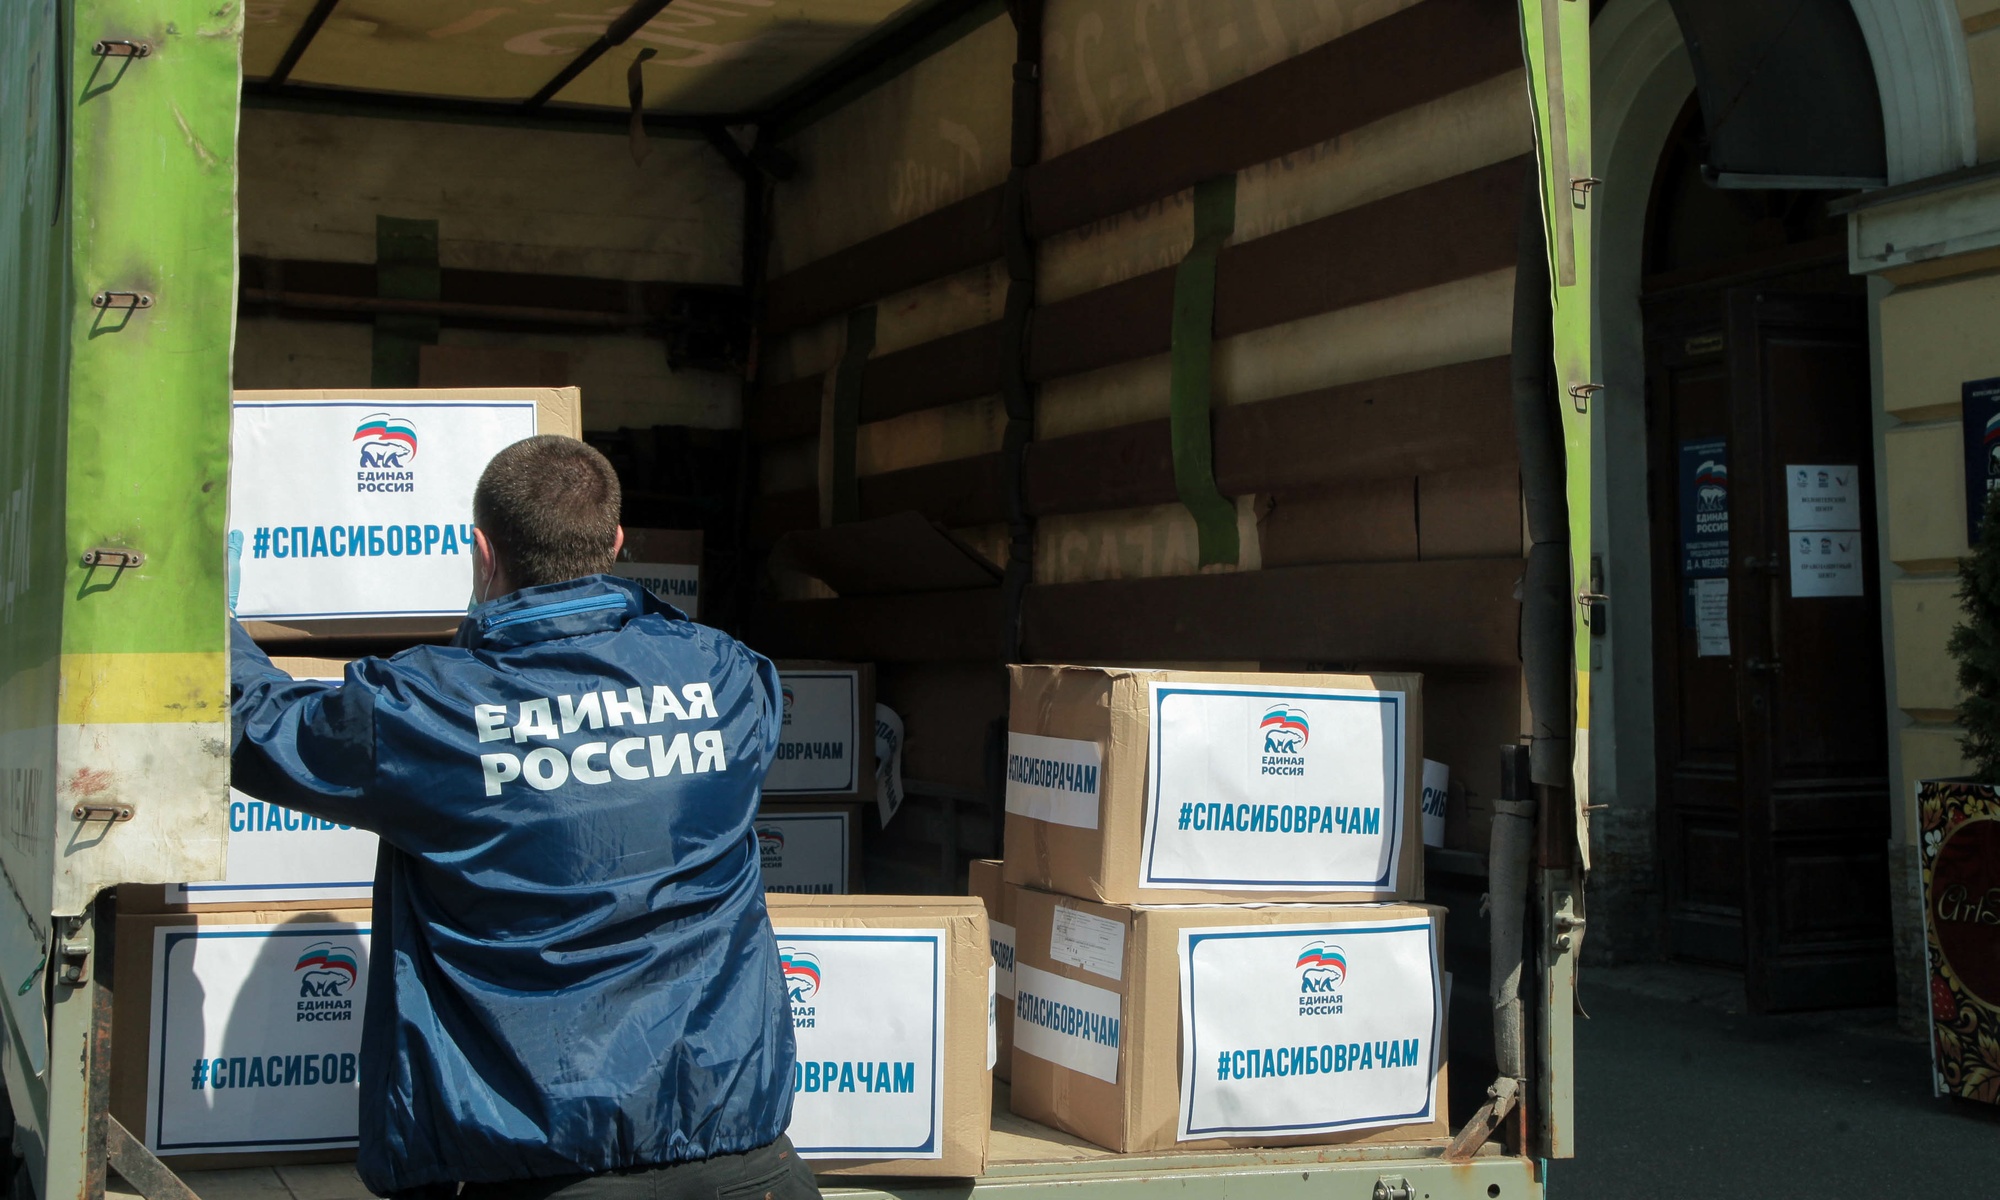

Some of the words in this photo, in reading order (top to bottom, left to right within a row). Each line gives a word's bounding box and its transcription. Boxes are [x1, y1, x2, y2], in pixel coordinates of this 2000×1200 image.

[357, 471, 414, 482] ЕДИНАЯ
[357, 482, 414, 492] РОССИЯ
[253, 524, 474, 558] #СПАСИБОВРАЧ
[474, 682, 719, 743] ЕДИНАЯ
[480, 730, 727, 797] РОССИЯ
[1261, 756, 1305, 766] ЕДИНАЯ
[1261, 766, 1305, 776] РОССИЯ
[1178, 802, 1380, 835] #СПАСИБОВРАЧАМ
[297, 1000, 352, 1011] ЕДИНАЯ
[1299, 994, 1343, 1006] ЕДИНАЯ
[296, 1010, 352, 1022] РОССИЯ
[1299, 1005, 1343, 1016] РОССИЯ
[1016, 990, 1119, 1049] #СПАСИБОВРАЧАМ
[1217, 1038, 1419, 1081] #СПАСИБОВРАЧАМ
[191, 1053, 361, 1090] #СПАСИБОВ
